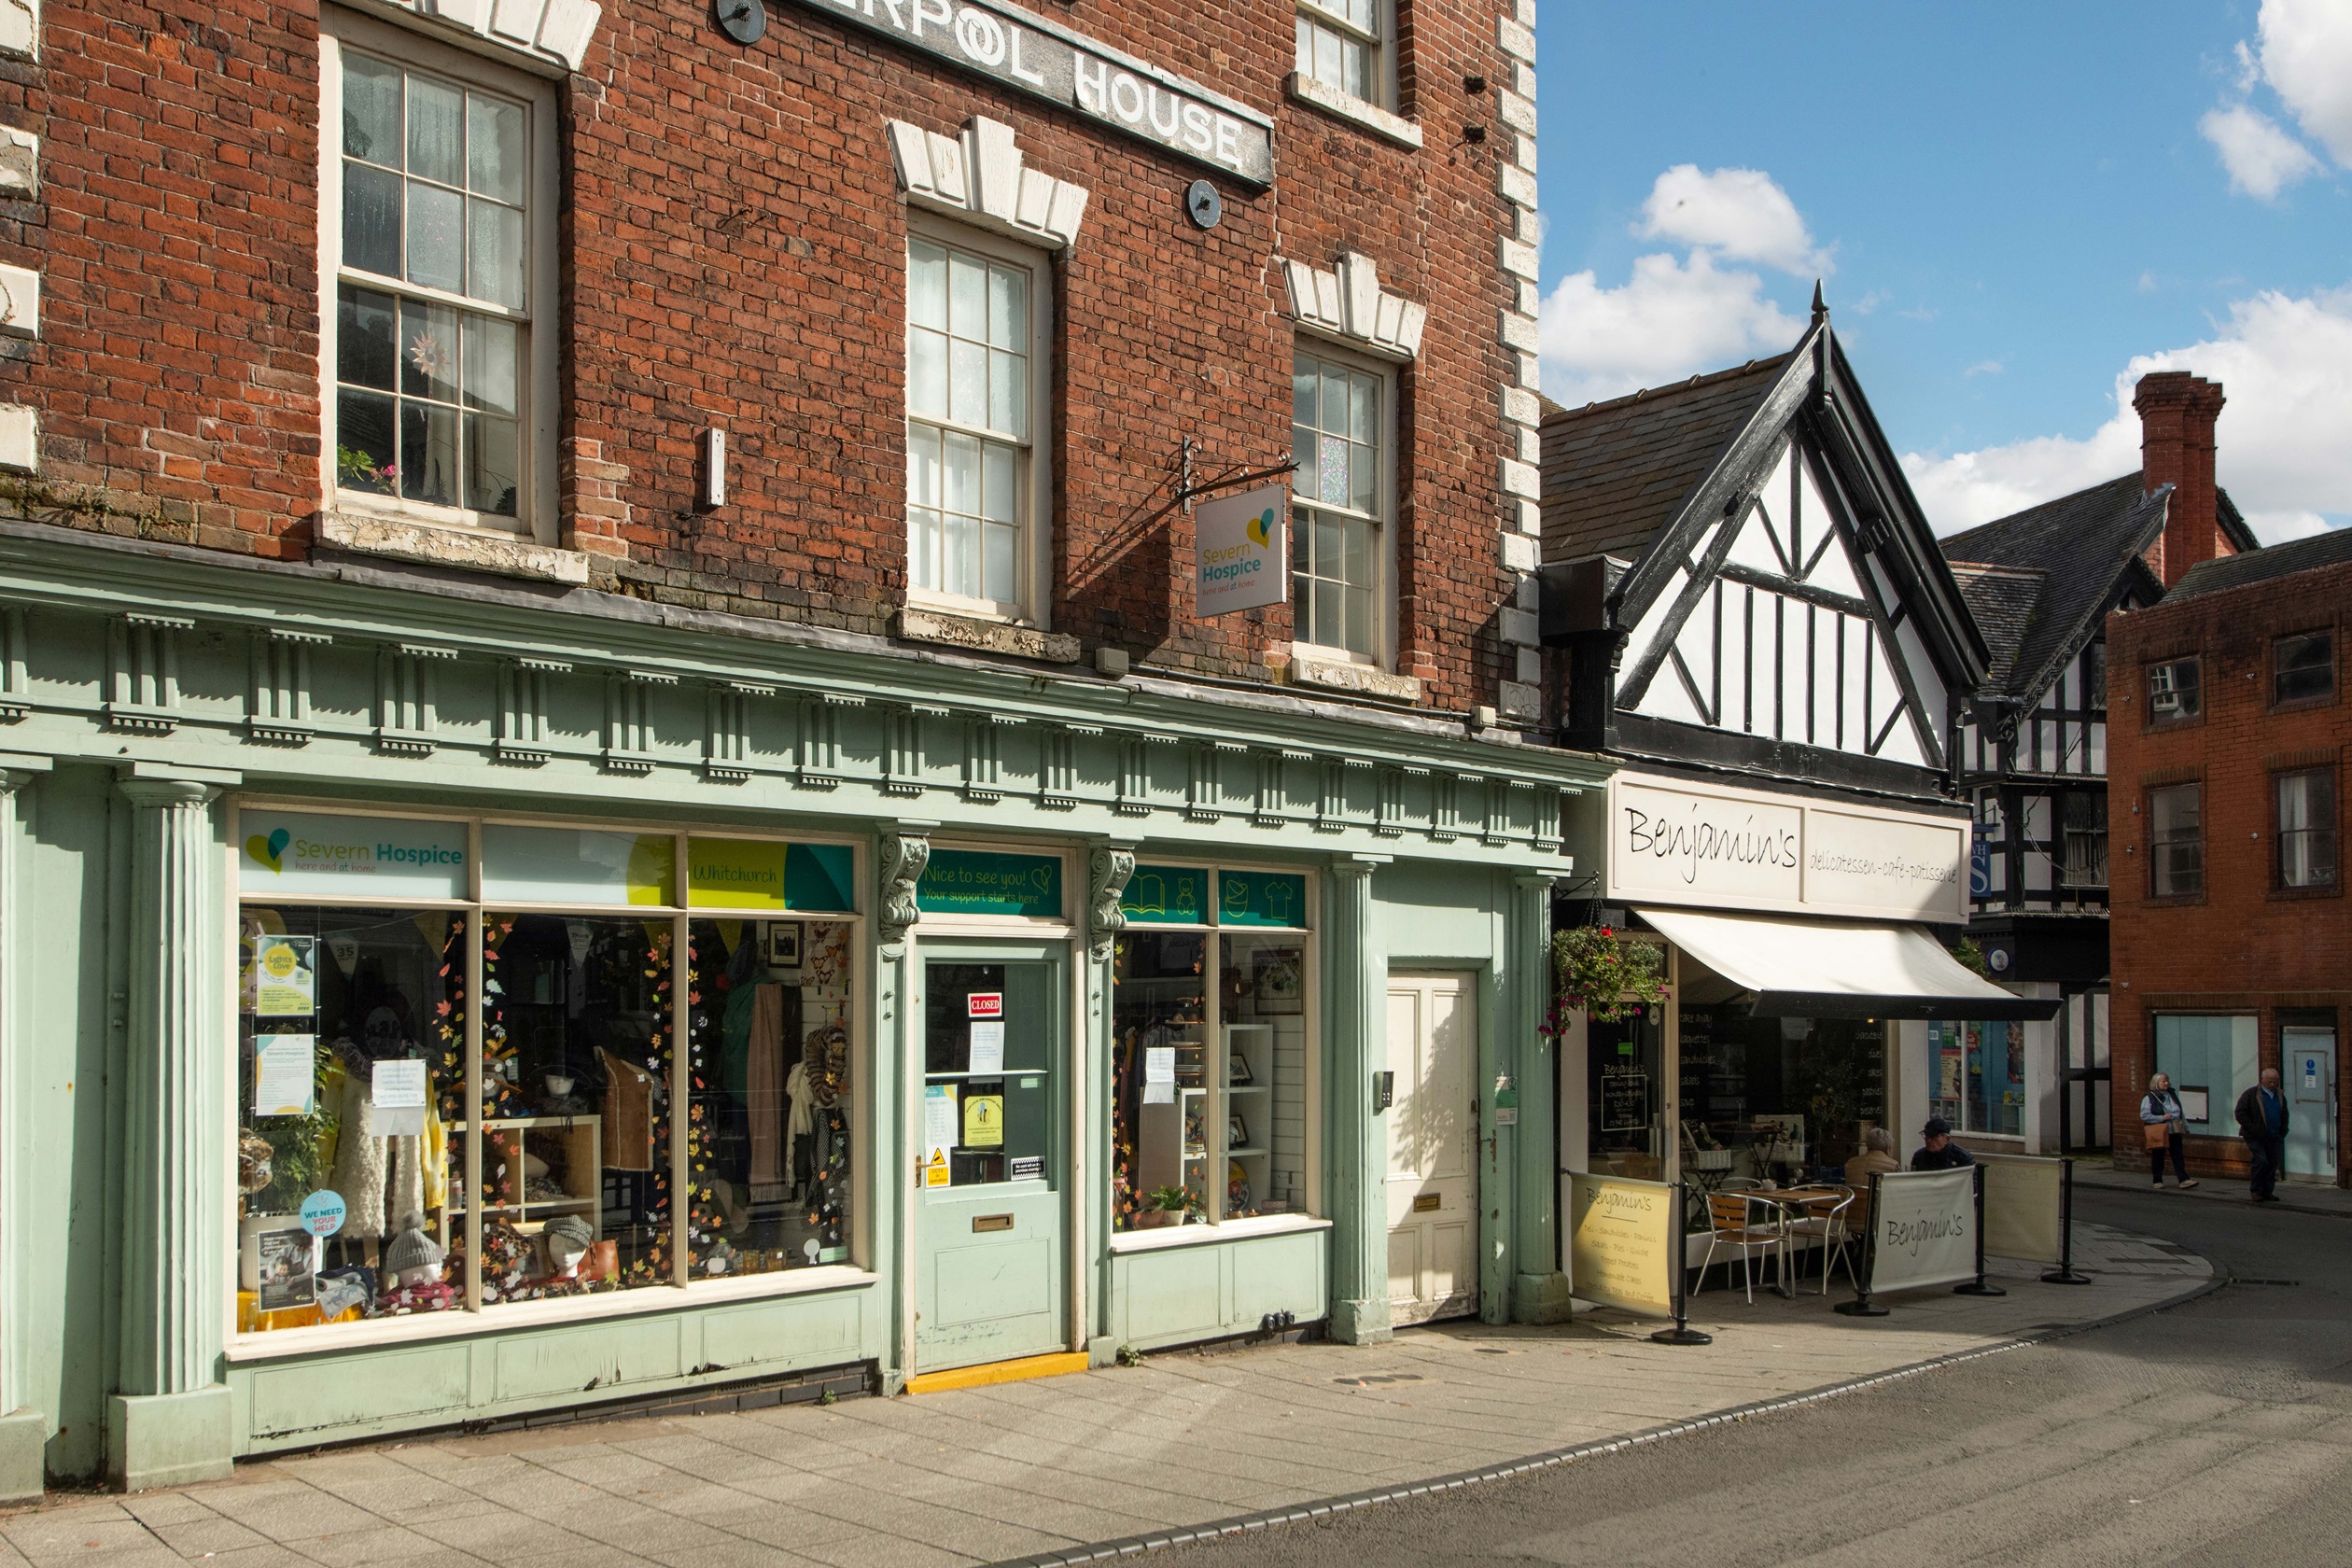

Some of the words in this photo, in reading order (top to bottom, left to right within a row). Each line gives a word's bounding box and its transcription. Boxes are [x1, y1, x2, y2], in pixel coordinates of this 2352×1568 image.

[1074, 51, 1243, 165] HOUSE
[1203, 542, 1251, 565] Severn
[1202, 557, 1262, 583] Hospice
[1202, 586, 1216, 596] here
[1217, 581, 1229, 593] and
[1229, 582, 1238, 592] at
[1238, 578, 1255, 590] home
[294, 838, 371, 861] Severn
[376, 843, 464, 867] Hospice
[1625, 803, 1798, 884] Benjamin's
[294, 860, 318, 871] here
[319, 861, 337, 872] and
[338, 862, 349, 873] at
[351, 861, 377, 874] home
[693, 864, 777, 883] Whitchurch
[1970, 855, 1988, 893] S
[924, 864, 956, 883] Nice
[958, 866, 973, 883] to
[975, 872, 998, 884] see
[1001, 870, 1026, 890] you!
[923, 888, 947, 901] Your
[948, 889, 987, 904] support
[988, 890, 1016, 903] starts
[1018, 891, 1039, 903] here
[269, 955, 293, 964] Lights
[338, 946, 355, 957] 35
[971, 1000, 1000, 1010] CLOSED
[1603, 1060, 1645, 1080] Benjamin's
[1586, 1185, 1653, 1214] Benjamin's
[304, 1211, 319, 1219] WE
[320, 1207, 343, 1217] NEED
[313, 1215, 336, 1225] YOUR
[314, 1223, 335, 1232] HELP
[1887, 1209, 1964, 1257] Benjamin's
